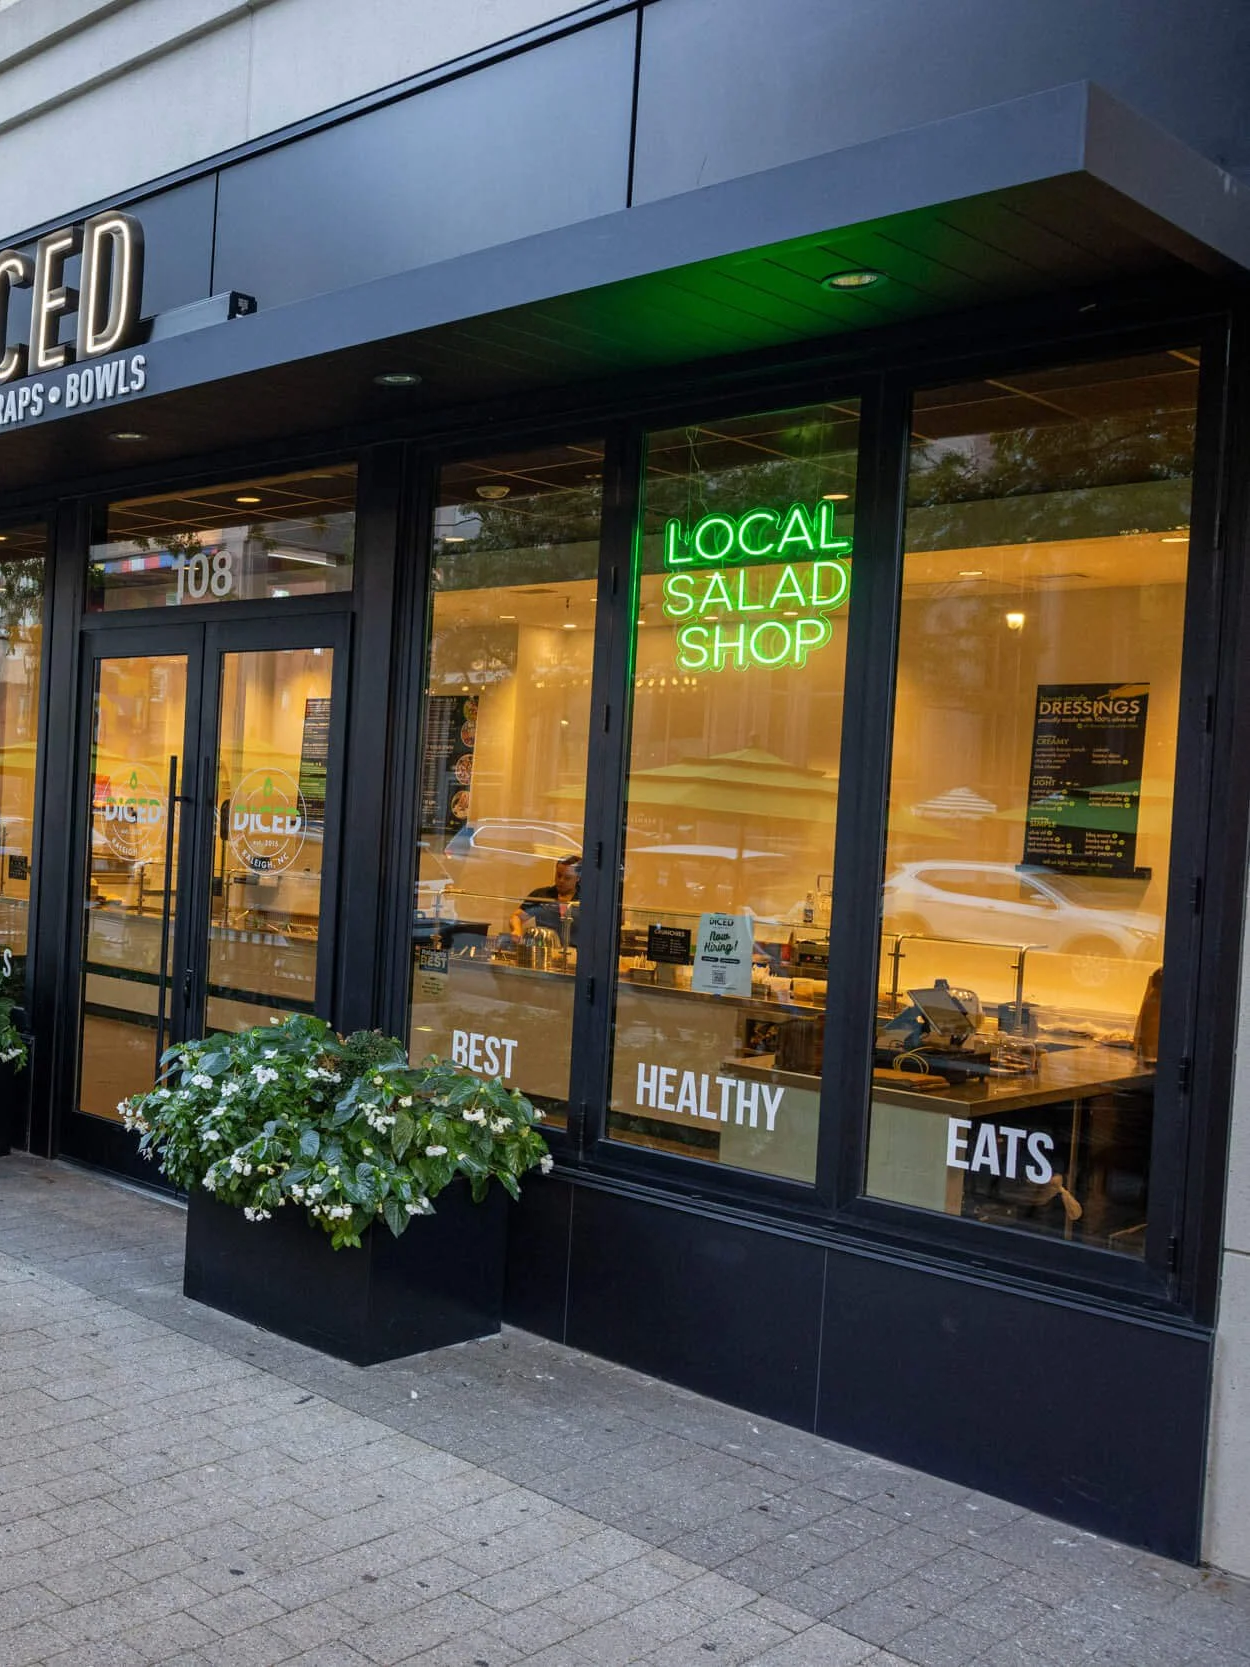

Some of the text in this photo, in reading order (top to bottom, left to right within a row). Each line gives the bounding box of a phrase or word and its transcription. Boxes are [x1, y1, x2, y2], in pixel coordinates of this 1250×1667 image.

[66, 355, 146, 408] BOWLS
[668, 504, 850, 564] LOCAL
[171, 550, 233, 606] 108
[666, 561, 847, 615] SALAD
[680, 618, 826, 668] SHOP
[1039, 700, 1141, 715] DRESSINGS
[233, 804, 301, 835] DICED
[709, 930, 731, 941] Now
[452, 1029, 518, 1079] BEST
[635, 1062, 785, 1131] HEALTHY
[946, 1117, 1055, 1184] EATS
